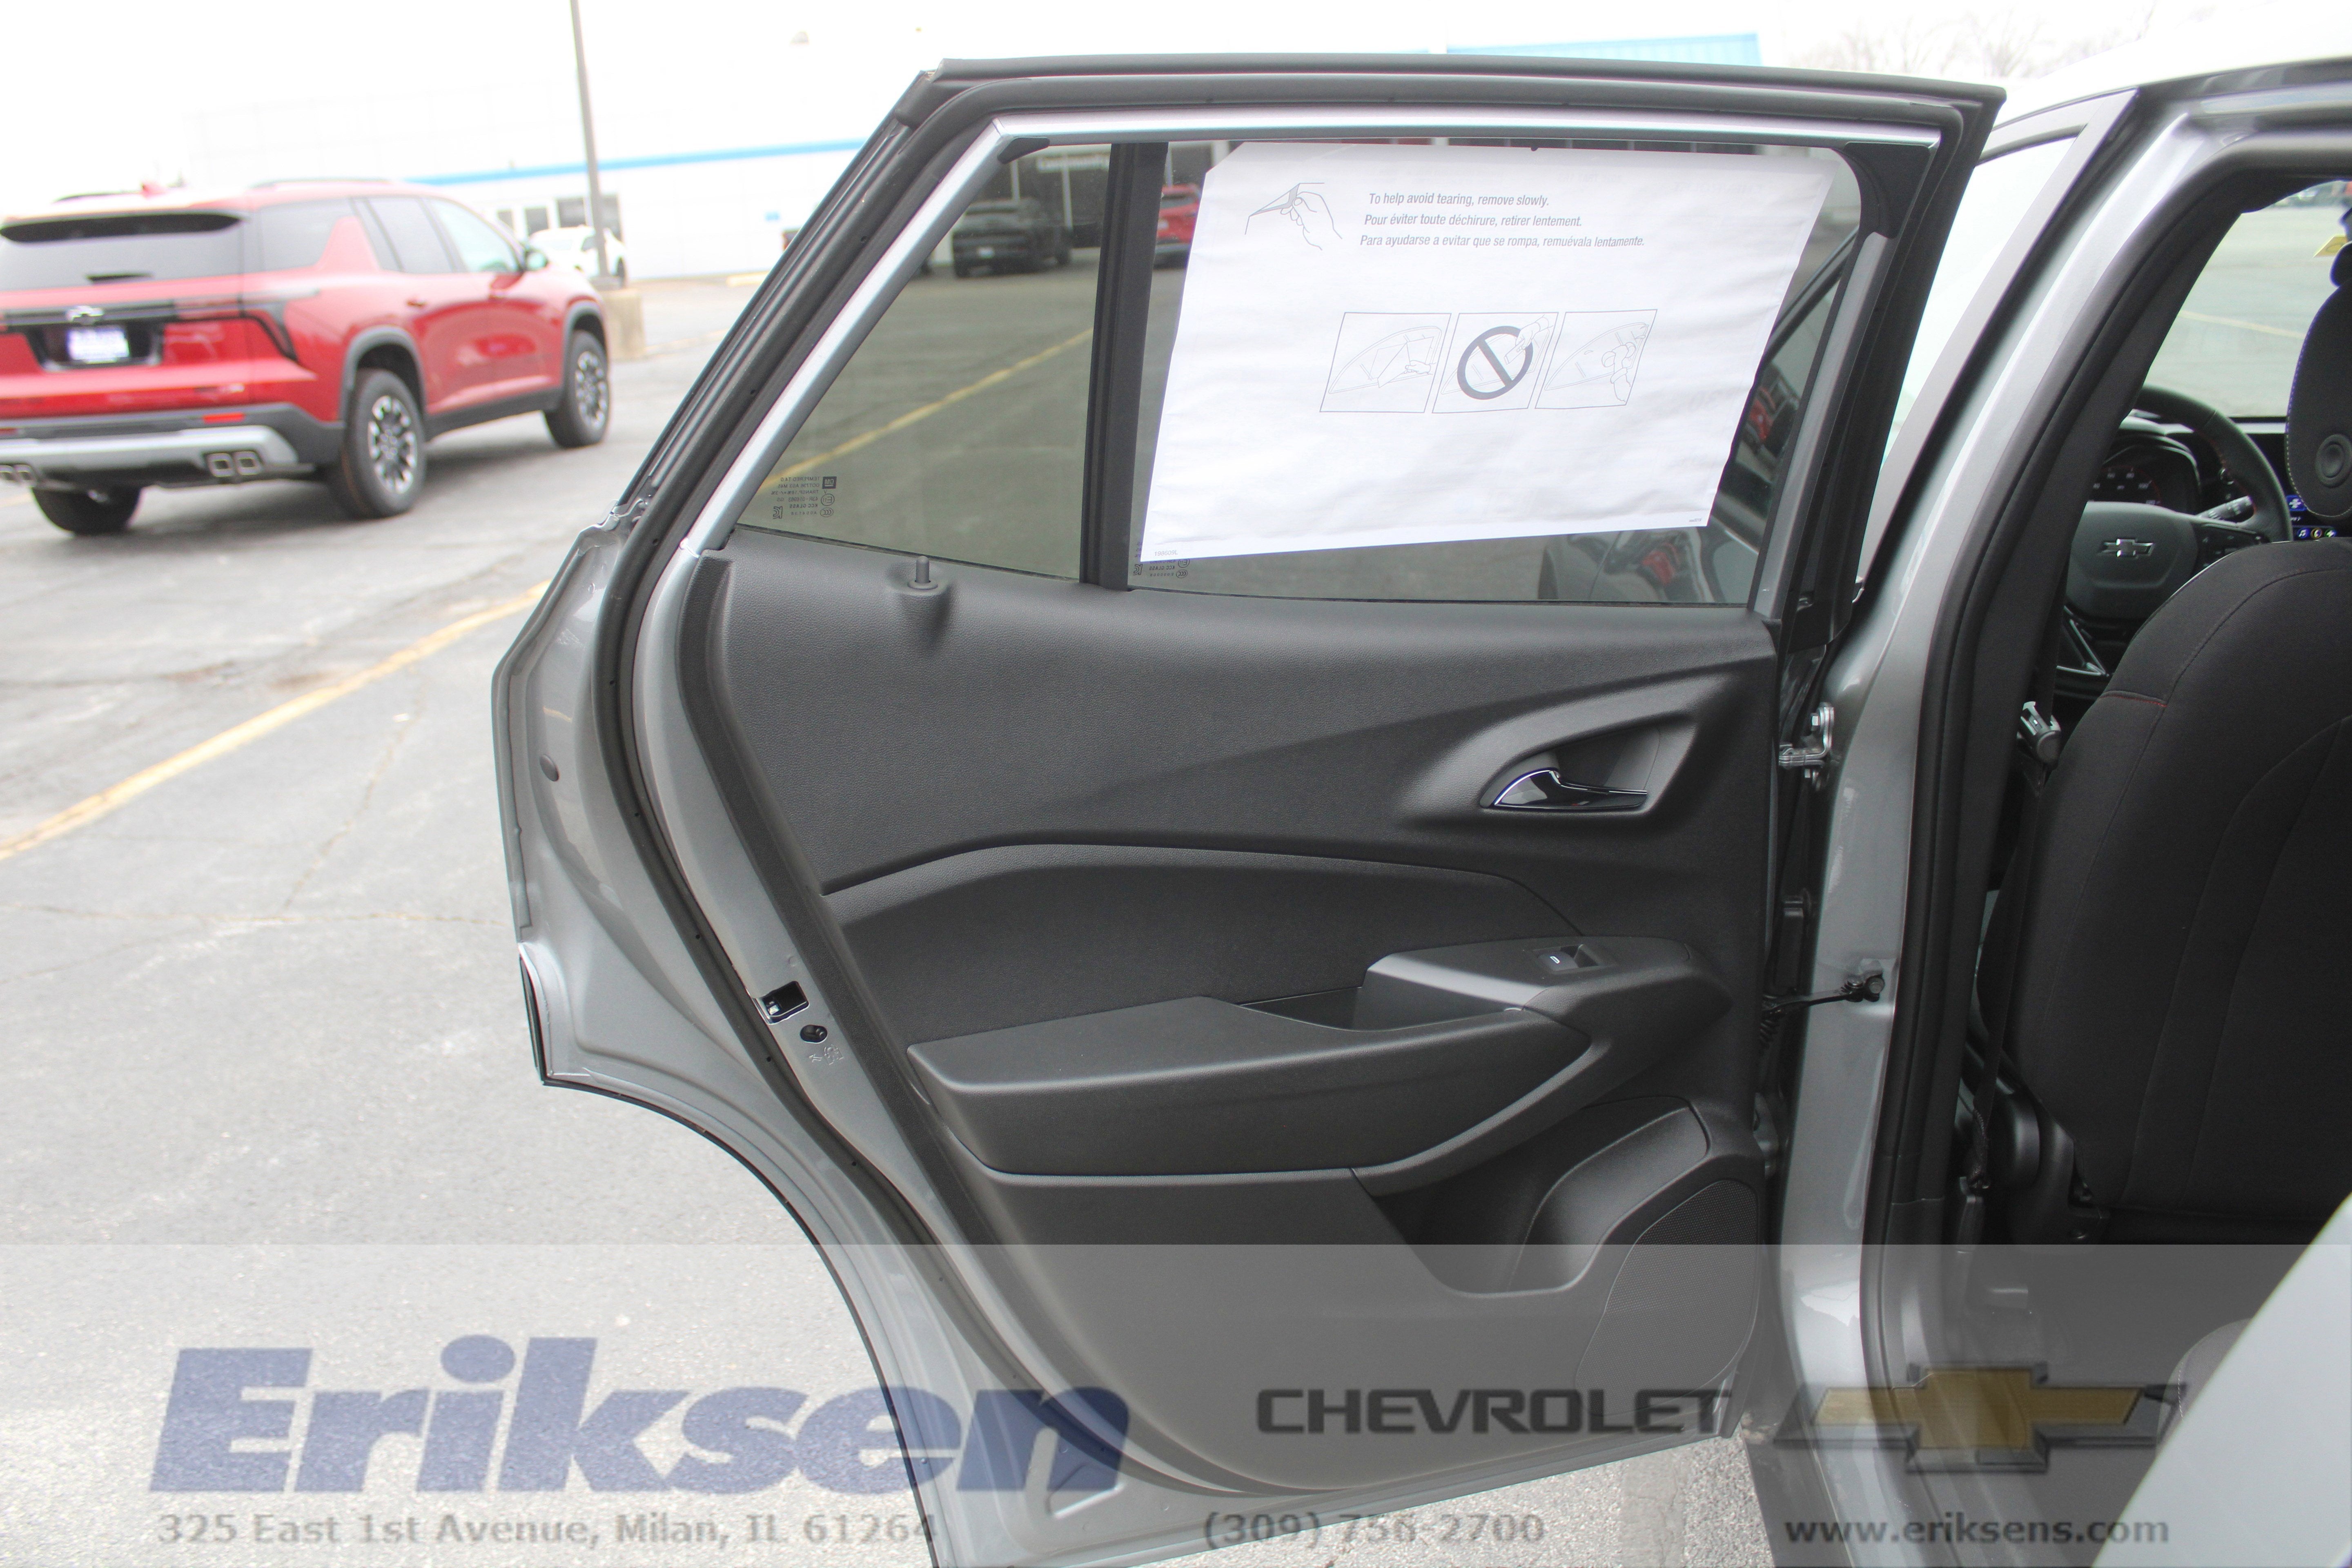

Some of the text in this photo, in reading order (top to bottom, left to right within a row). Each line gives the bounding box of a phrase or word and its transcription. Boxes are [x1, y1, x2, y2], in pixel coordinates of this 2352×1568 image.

[1370, 193, 1549, 208] To help avoid tearing, remove slowly.
[1364, 214, 1582, 227] Pour éviter toute déchirure, retirer lentement.
[1360, 235, 1382, 245] Para
[1385, 235, 1430, 247] ayudarse
[1443, 235, 1470, 246] evitar
[1473, 237, 1491, 248] que
[1493, 238, 1504, 246] se
[1507, 237, 1539, 248] rompa,
[1543, 236, 1592, 247] remuévala
[1594, 236, 1644, 247] lentamente.
